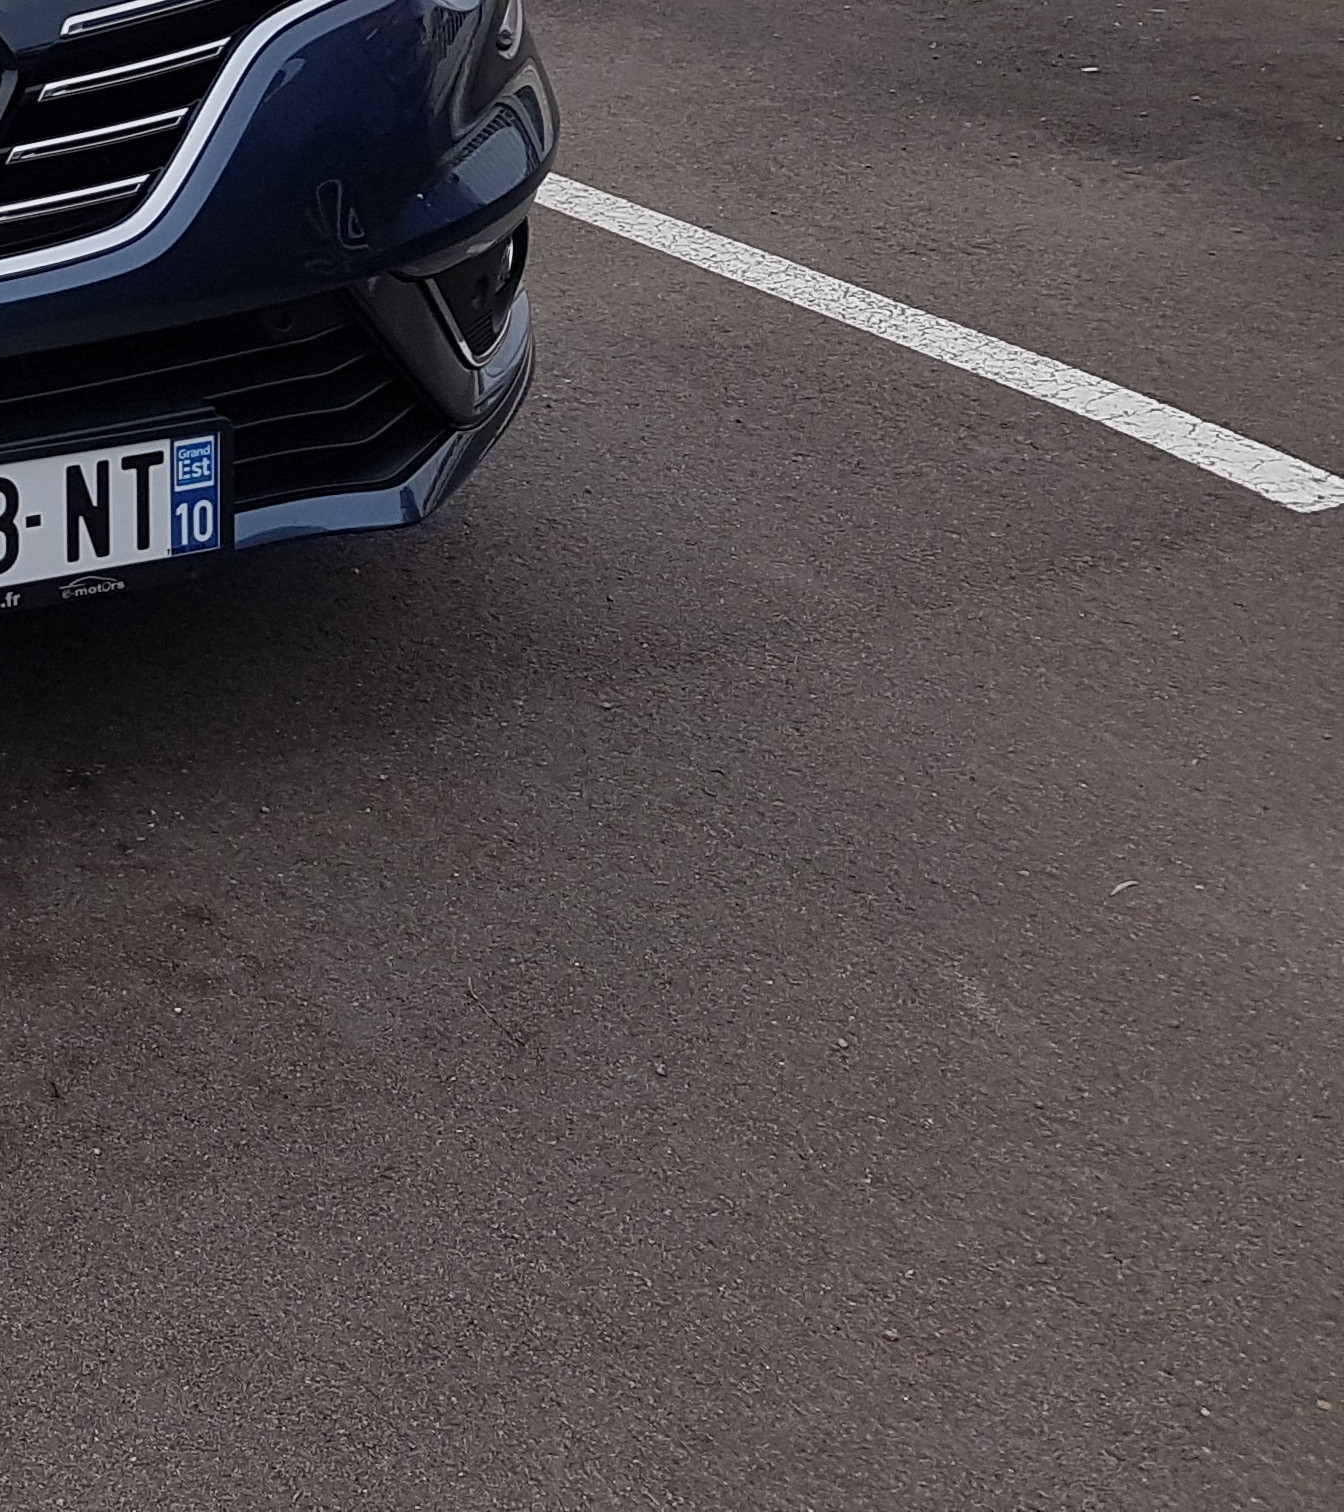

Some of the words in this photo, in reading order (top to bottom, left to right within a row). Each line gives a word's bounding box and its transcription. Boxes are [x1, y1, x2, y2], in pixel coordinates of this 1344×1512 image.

[178, 444, 211, 460] Grand
[178, 457, 211, 480] Est
[175, 499, 214, 546] 10
